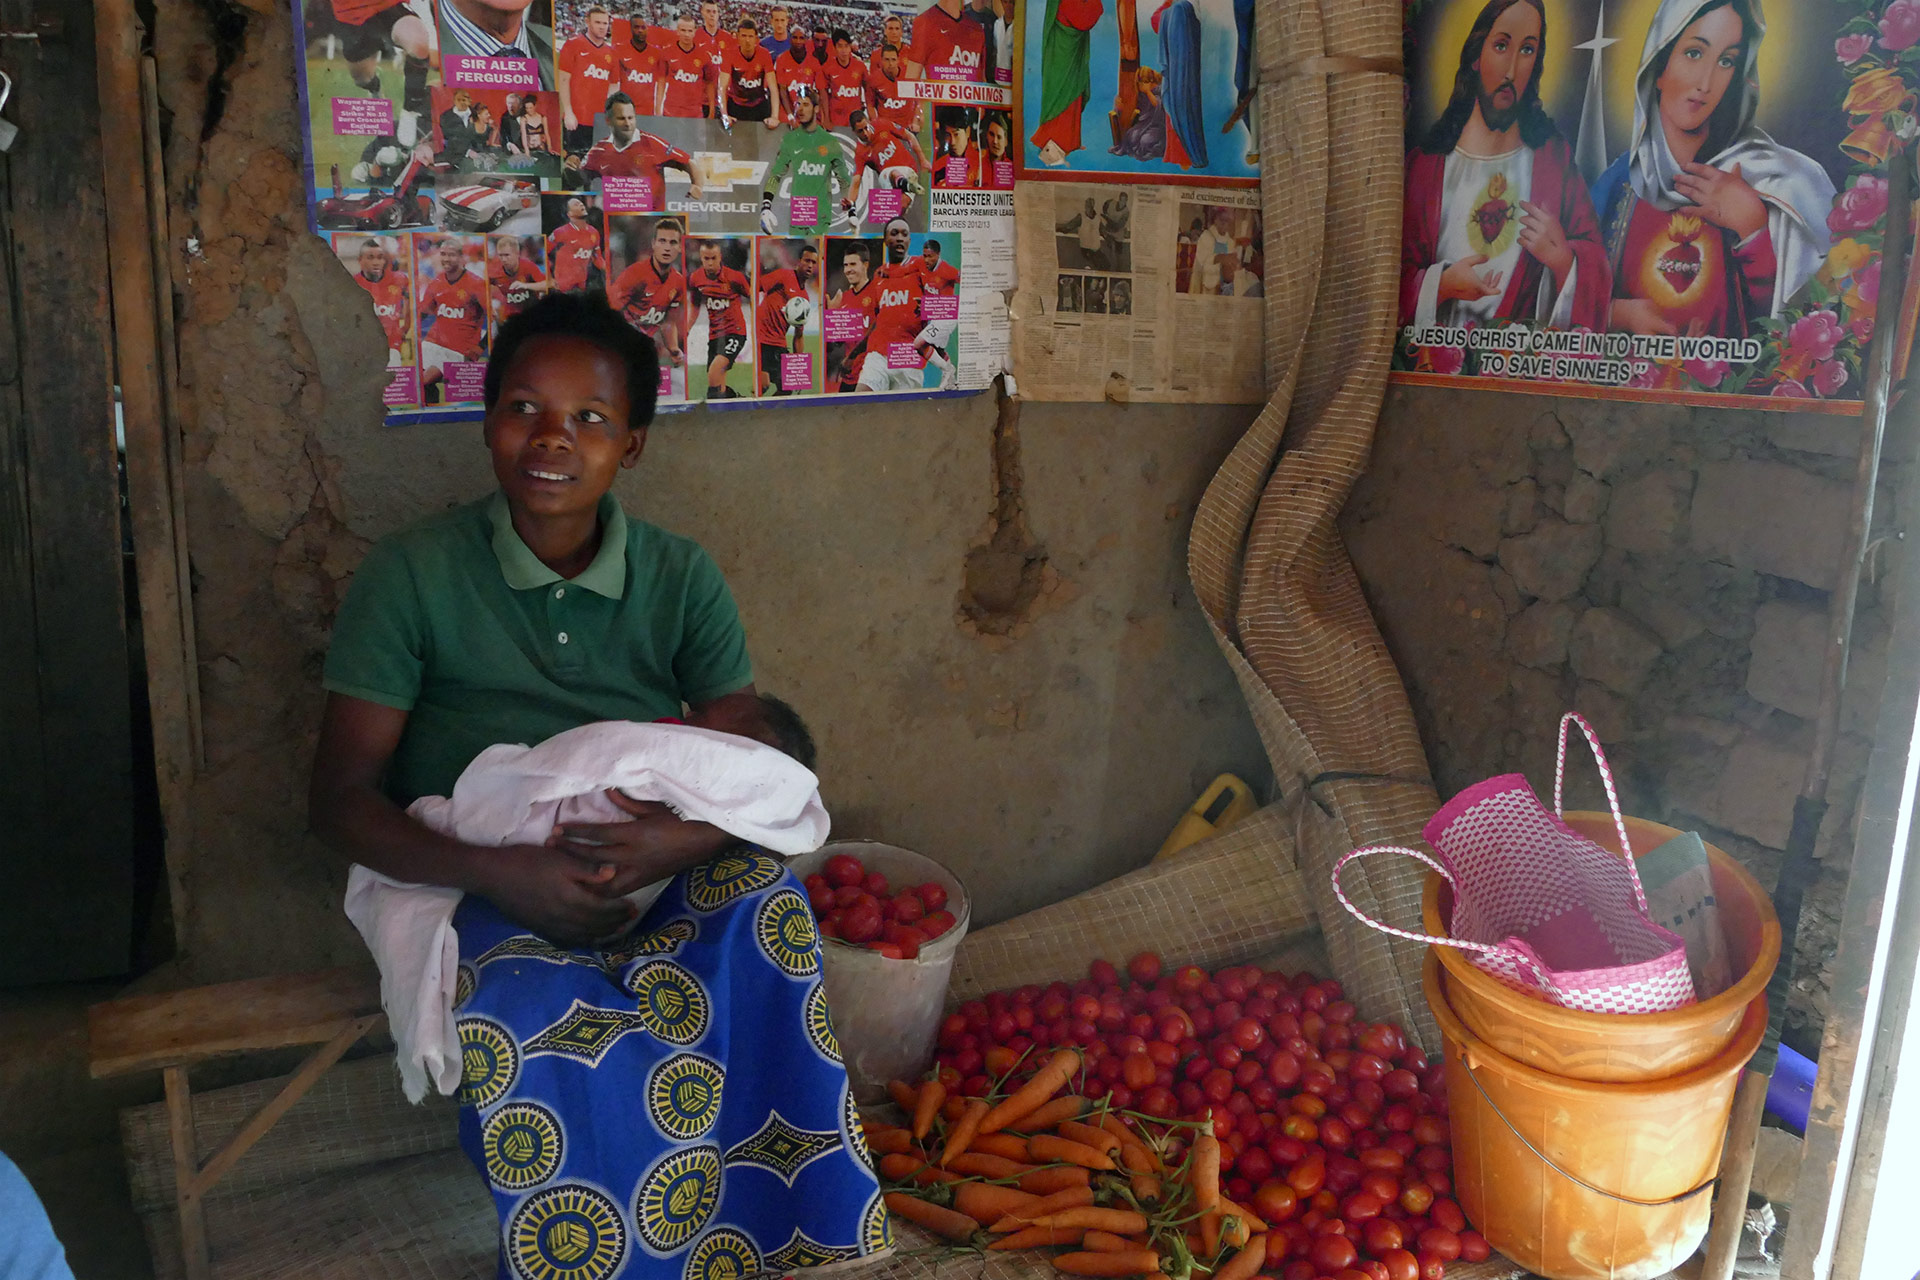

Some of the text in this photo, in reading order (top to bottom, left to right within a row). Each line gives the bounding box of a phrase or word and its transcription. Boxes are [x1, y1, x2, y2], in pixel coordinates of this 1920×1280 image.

[949, 45, 980, 67] AON
[461, 59, 527, 71] SIR ALEX
[584, 64, 610, 80] AON
[934, 66, 957, 74] ROBIN
[456, 71, 534, 85] FERGUSON
[628, 69, 653, 83] AON
[674, 69, 699, 82] AON
[940, 73, 967, 81] PERSIE
[738, 78, 762, 89] AON
[837, 85, 859, 97] AON
[914, 82, 1003, 103] NEW SIGNINGS
[798, 160, 825, 175] AON
[932, 192, 991, 206] MANCHESTER
[667, 201, 758, 213] CHEVROLET
[933, 208, 968, 216] BARCLAYS
[970, 208, 998, 217] PREMIER
[932, 220, 990, 229] FIXTURES 2012/13
[880, 289, 909, 309] AON
[437, 304, 464, 318] AON
[927, 324, 939, 338] 25
[725, 338, 739, 353] 23
[1470, 330, 1528, 350] CHRIST
[1532, 332, 1580, 352] CAME
[1585, 335, 1602, 353] IN
[1607, 336, 1629, 355] TO
[1634, 337, 1674, 357] THE
[1679, 339, 1760, 361] WORLD
[1483, 355, 1504, 373] TO
[1508, 357, 1551, 376] SAVE
